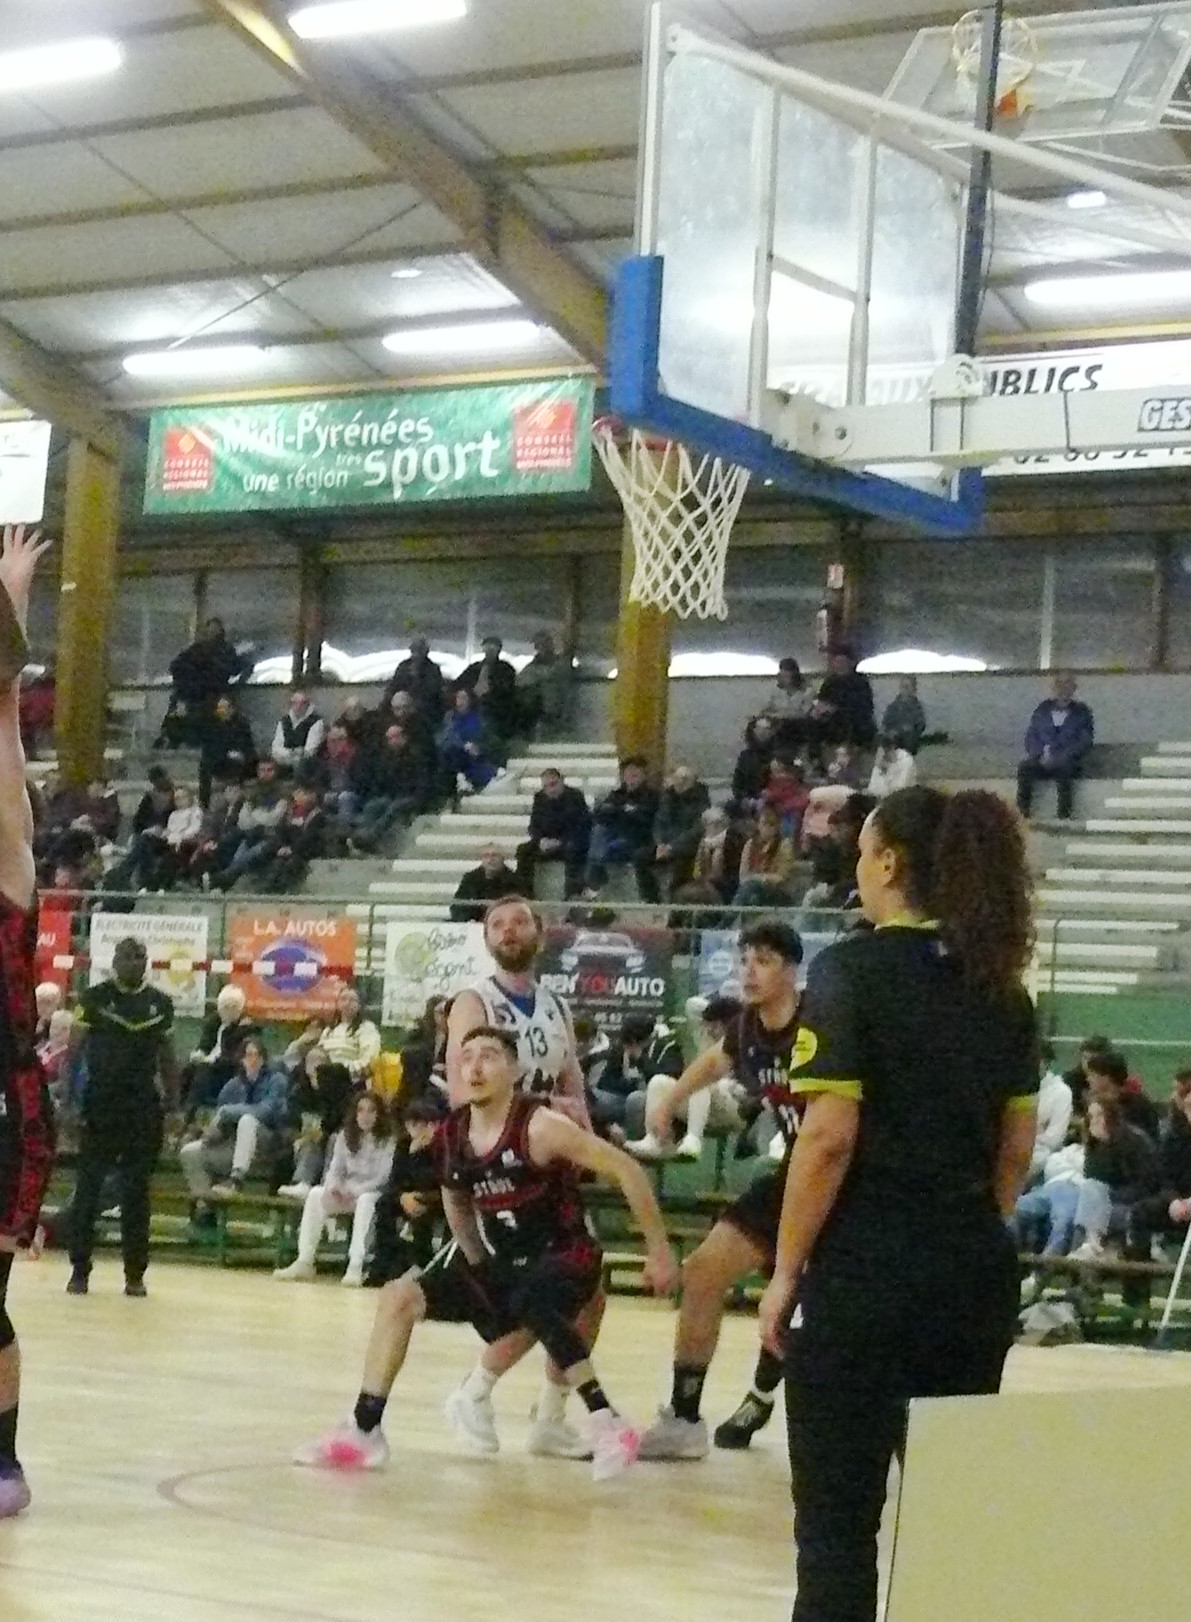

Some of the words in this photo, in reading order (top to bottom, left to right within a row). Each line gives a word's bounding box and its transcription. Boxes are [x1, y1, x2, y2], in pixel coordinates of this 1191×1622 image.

[242, 473, 280, 493] une
[286, 463, 350, 495] région
[363, 430, 501, 499] sport
[284, 920, 338, 937] AUTOS
[525, 1026, 549, 1057] 13
